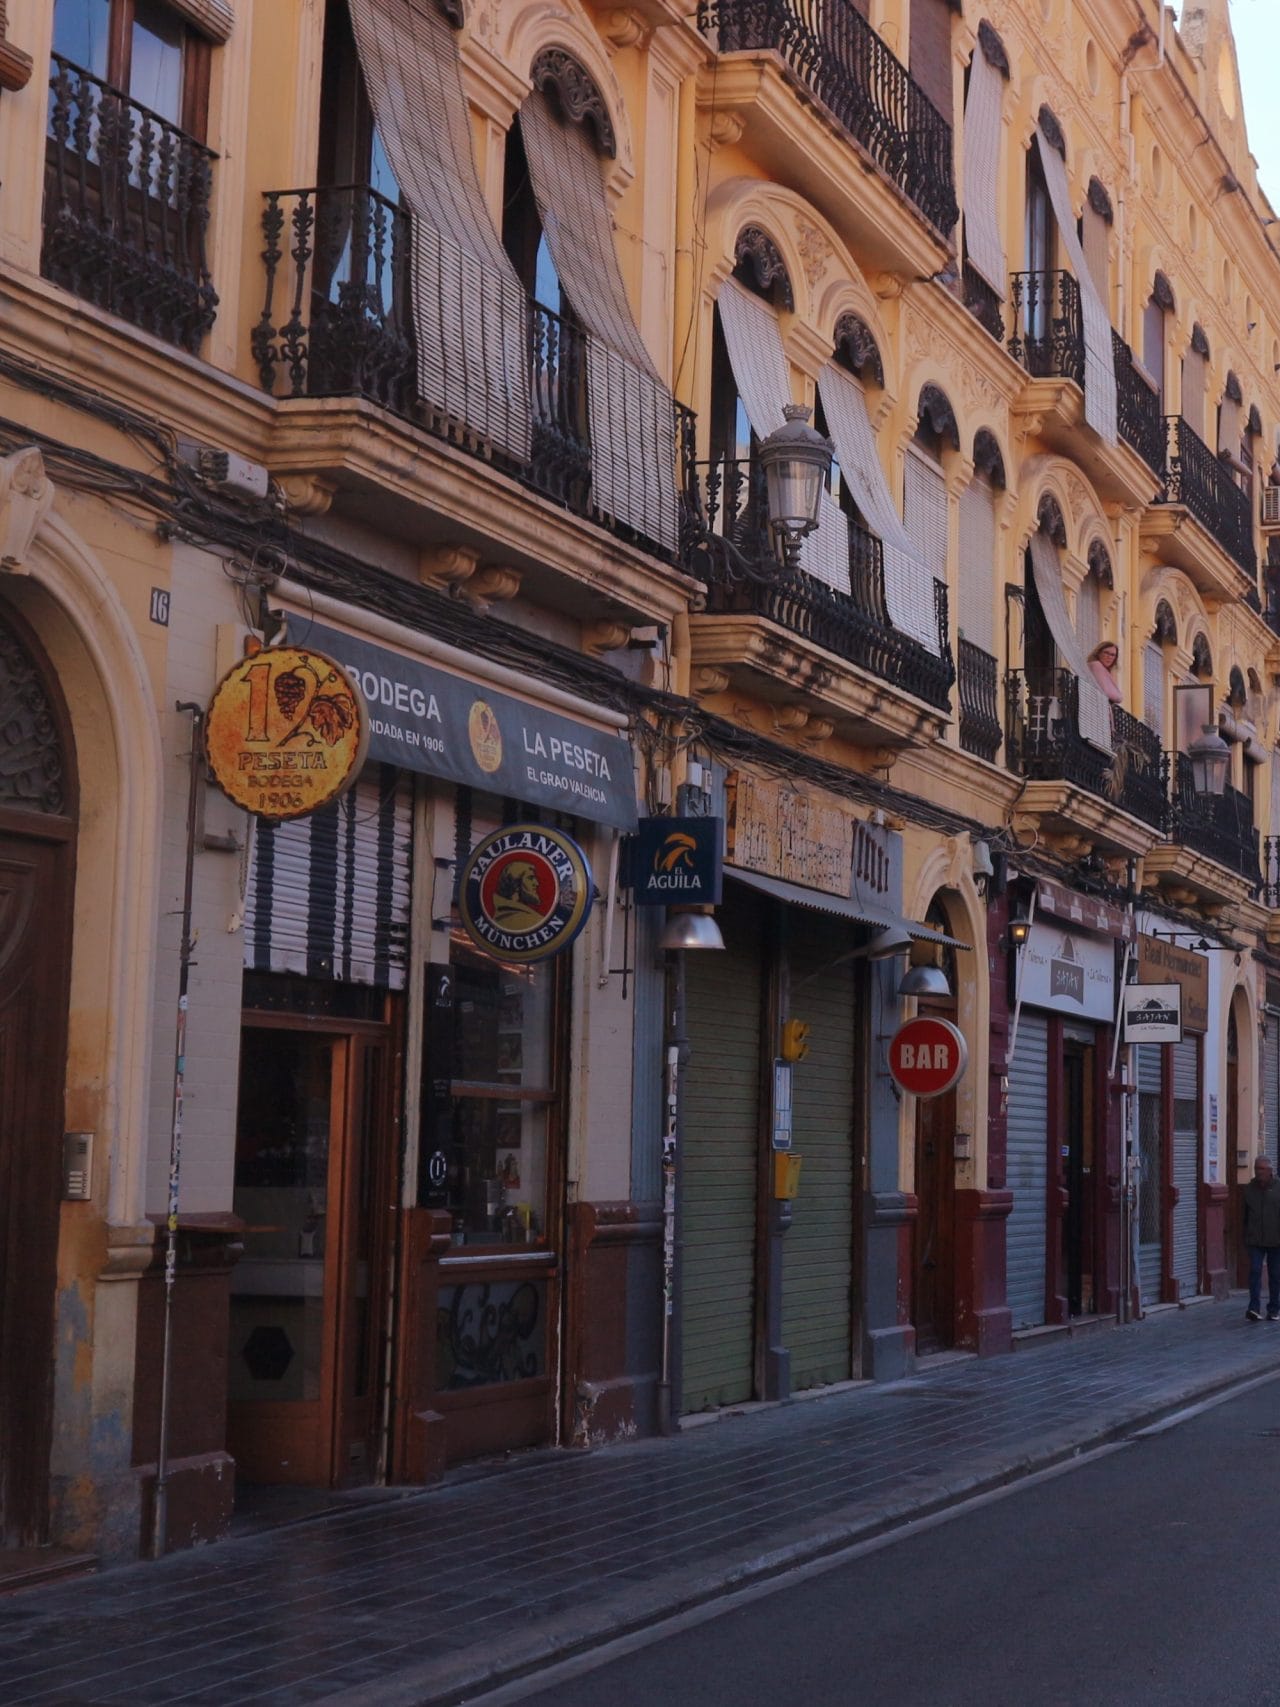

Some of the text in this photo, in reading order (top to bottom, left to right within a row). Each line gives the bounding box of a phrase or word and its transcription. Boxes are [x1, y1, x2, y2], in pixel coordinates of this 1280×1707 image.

[151, 590, 168, 623] 16
[368, 718, 444, 753] NDADA EN 1906
[238, 751, 328, 771] PESETA
[523, 728, 548, 759] LA
[550, 737, 611, 781] PESETA
[247, 774, 314, 789] BODEGA
[526, 766, 607, 805] EL GRAO VALENCIA
[258, 792, 304, 809] 1906
[469, 832, 574, 882] PAULANER
[674, 866, 684, 875] EL
[474, 915, 565, 950] MÜNCHEN
[900, 1043, 948, 1069] BAR
